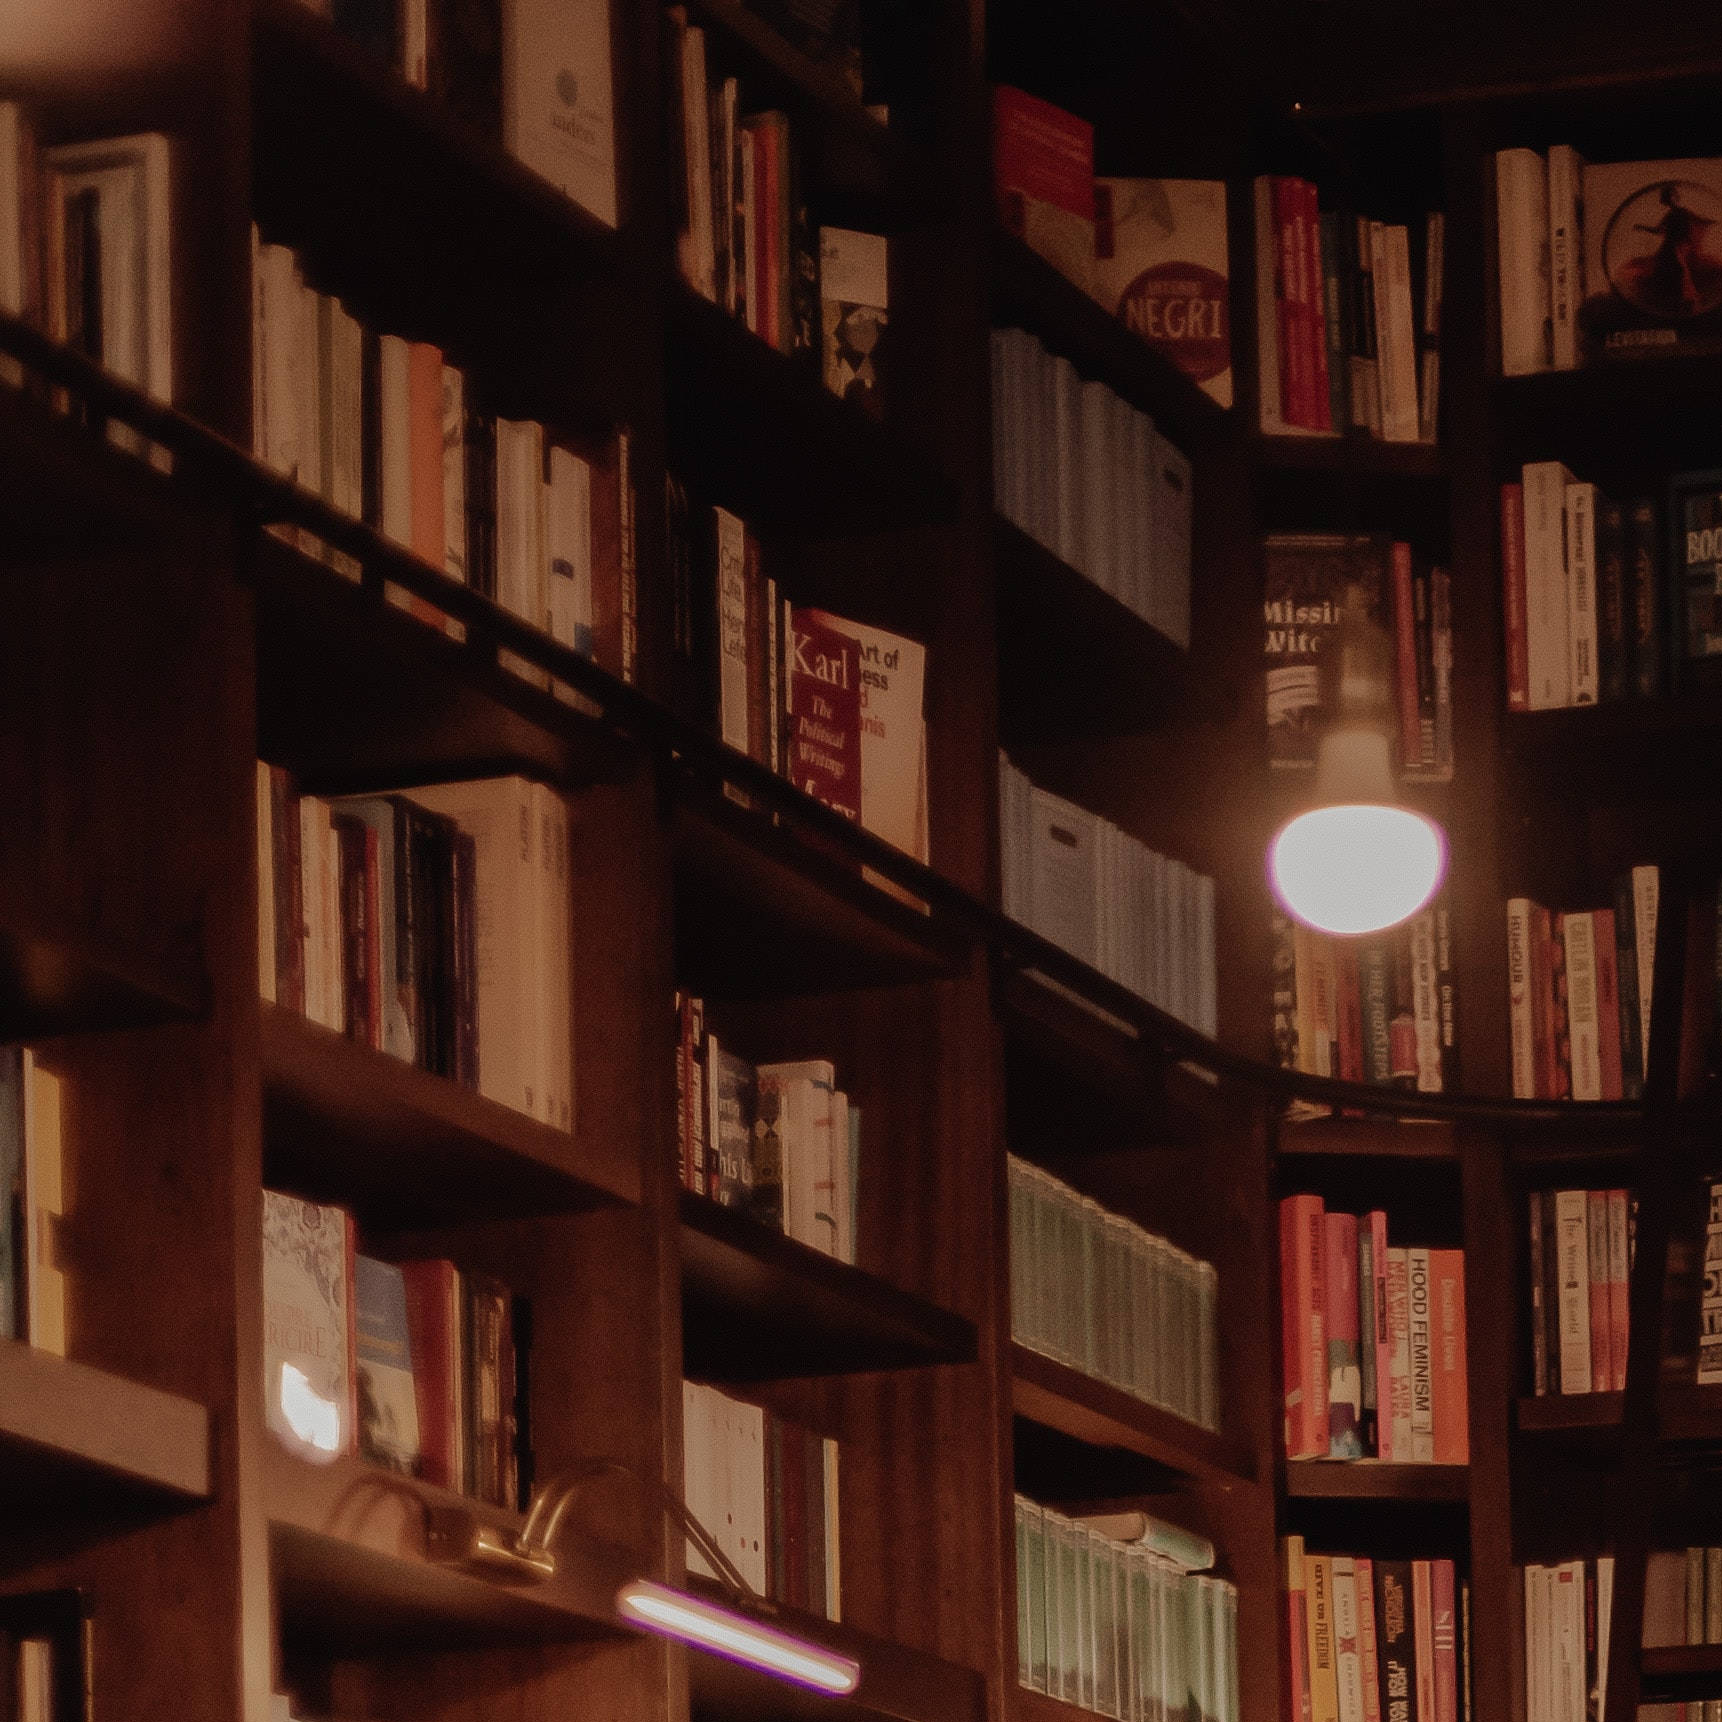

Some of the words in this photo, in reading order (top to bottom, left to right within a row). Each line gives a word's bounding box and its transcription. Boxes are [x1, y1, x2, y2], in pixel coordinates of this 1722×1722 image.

[1127, 298, 1223, 340] NEGRI
[795, 632, 849, 690] Karl
[884, 650, 900, 670] of
[1511, 915, 1523, 983] HUMOUR
[1411, 1258, 1428, 1315] HOOD
[1412, 1320, 1430, 1411] FEMINISM
[1316, 1622, 1330, 1670] FREEDOM
